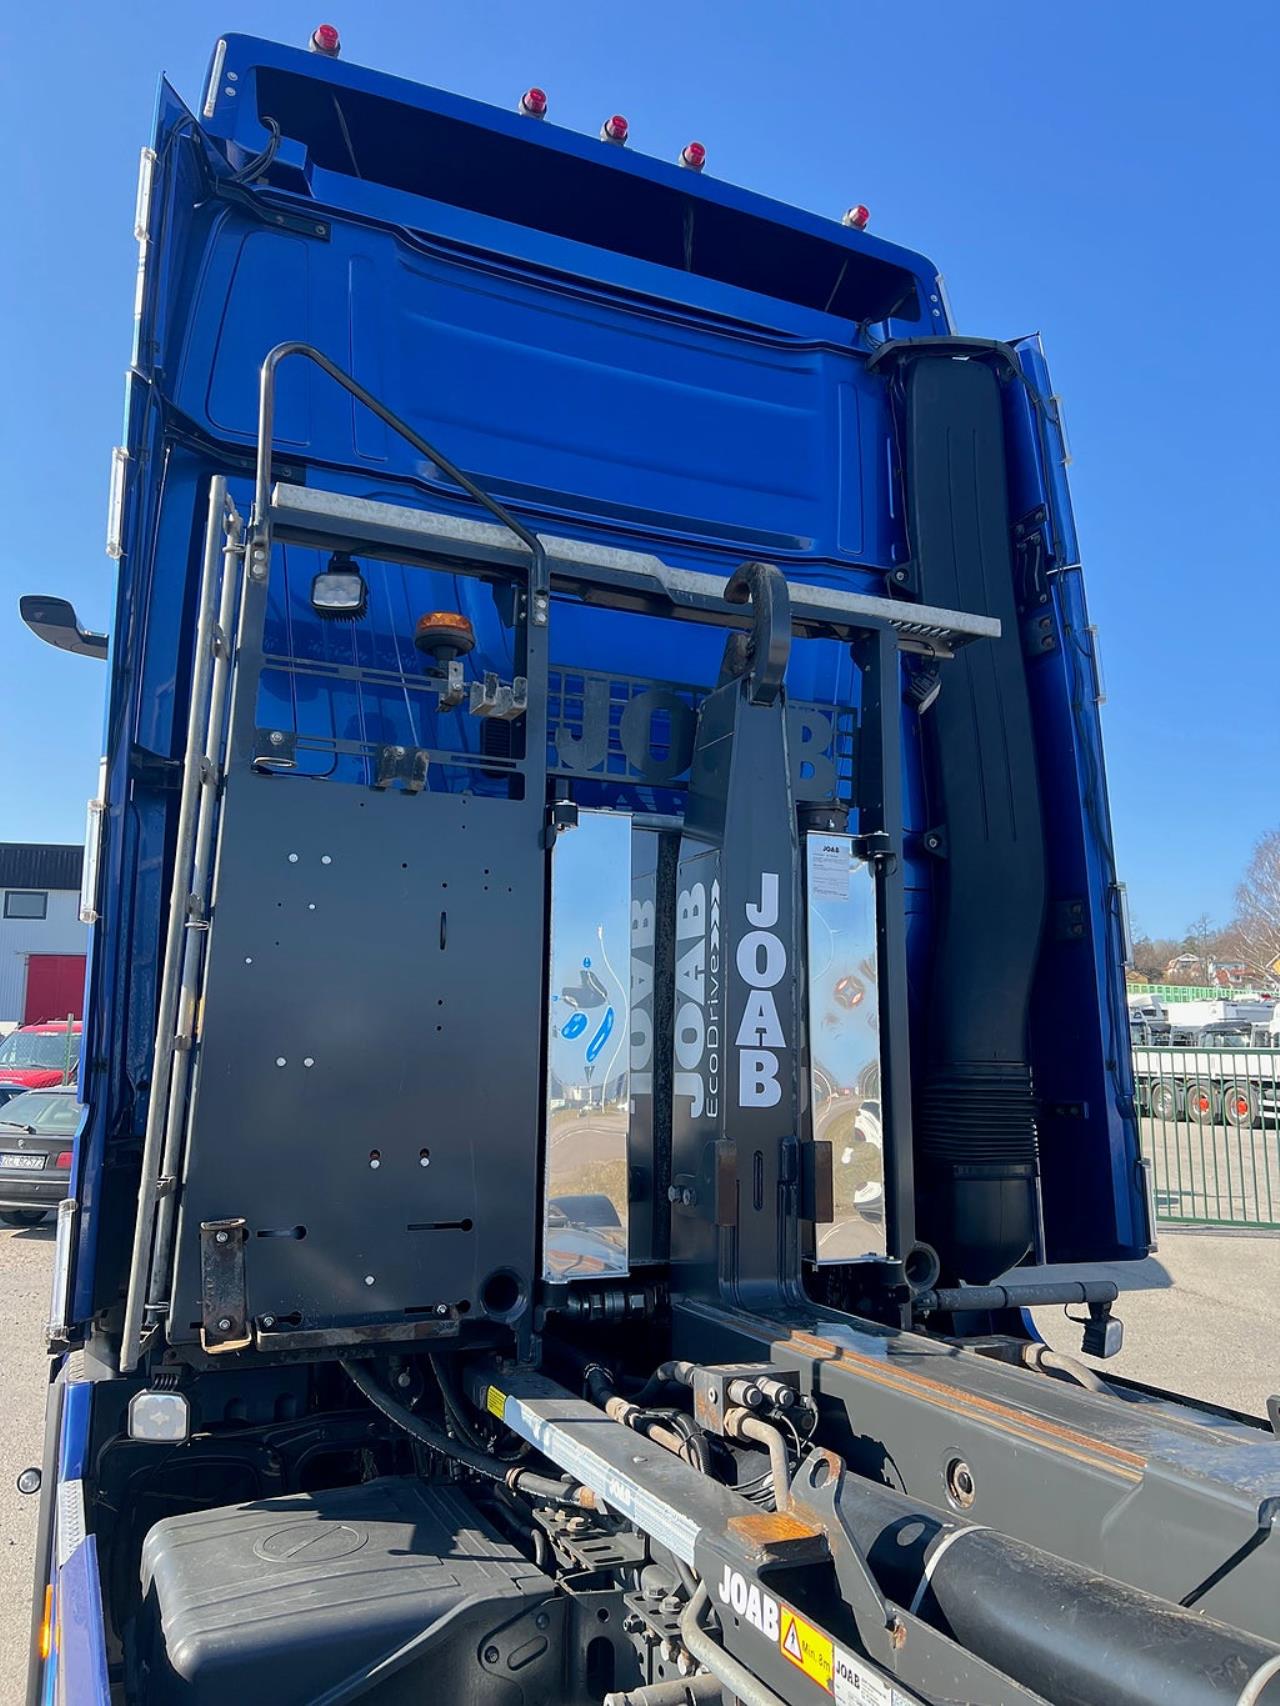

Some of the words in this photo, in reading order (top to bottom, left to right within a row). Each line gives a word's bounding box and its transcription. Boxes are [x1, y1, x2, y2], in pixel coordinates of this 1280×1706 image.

[555, 677, 838, 801] JOB
[673, 882, 706, 1118] JOAB
[706, 954, 720, 1118] EcoDrive
[735, 872, 787, 1108] JOAB
[718, 1564, 780, 1642] JOAB
[836, 1660, 861, 1690] JOAB
